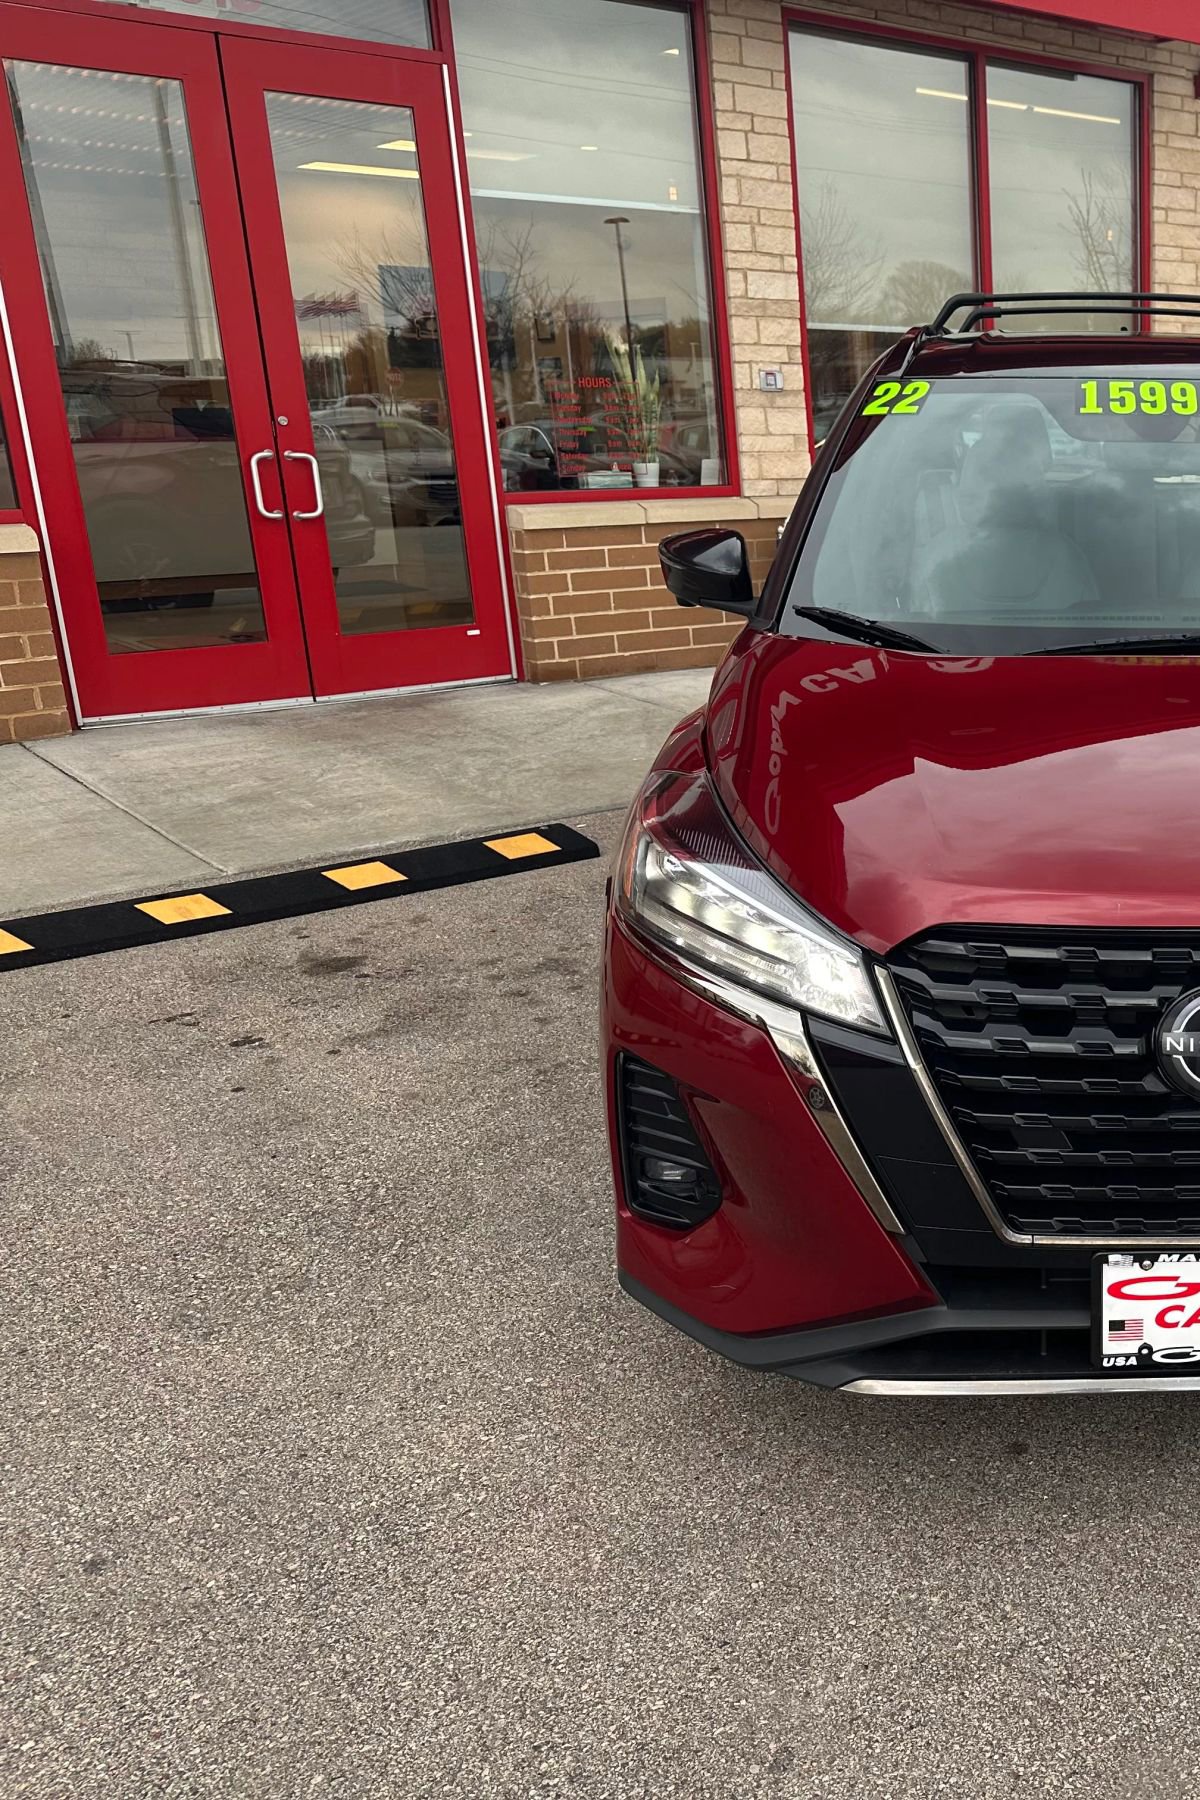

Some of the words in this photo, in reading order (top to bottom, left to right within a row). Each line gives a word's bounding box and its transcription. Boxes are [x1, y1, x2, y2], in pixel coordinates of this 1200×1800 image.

[578, 376, 612, 389] HOURS
[862, 381, 931, 416] 22
[1102, 1356, 1138, 1368] USA
